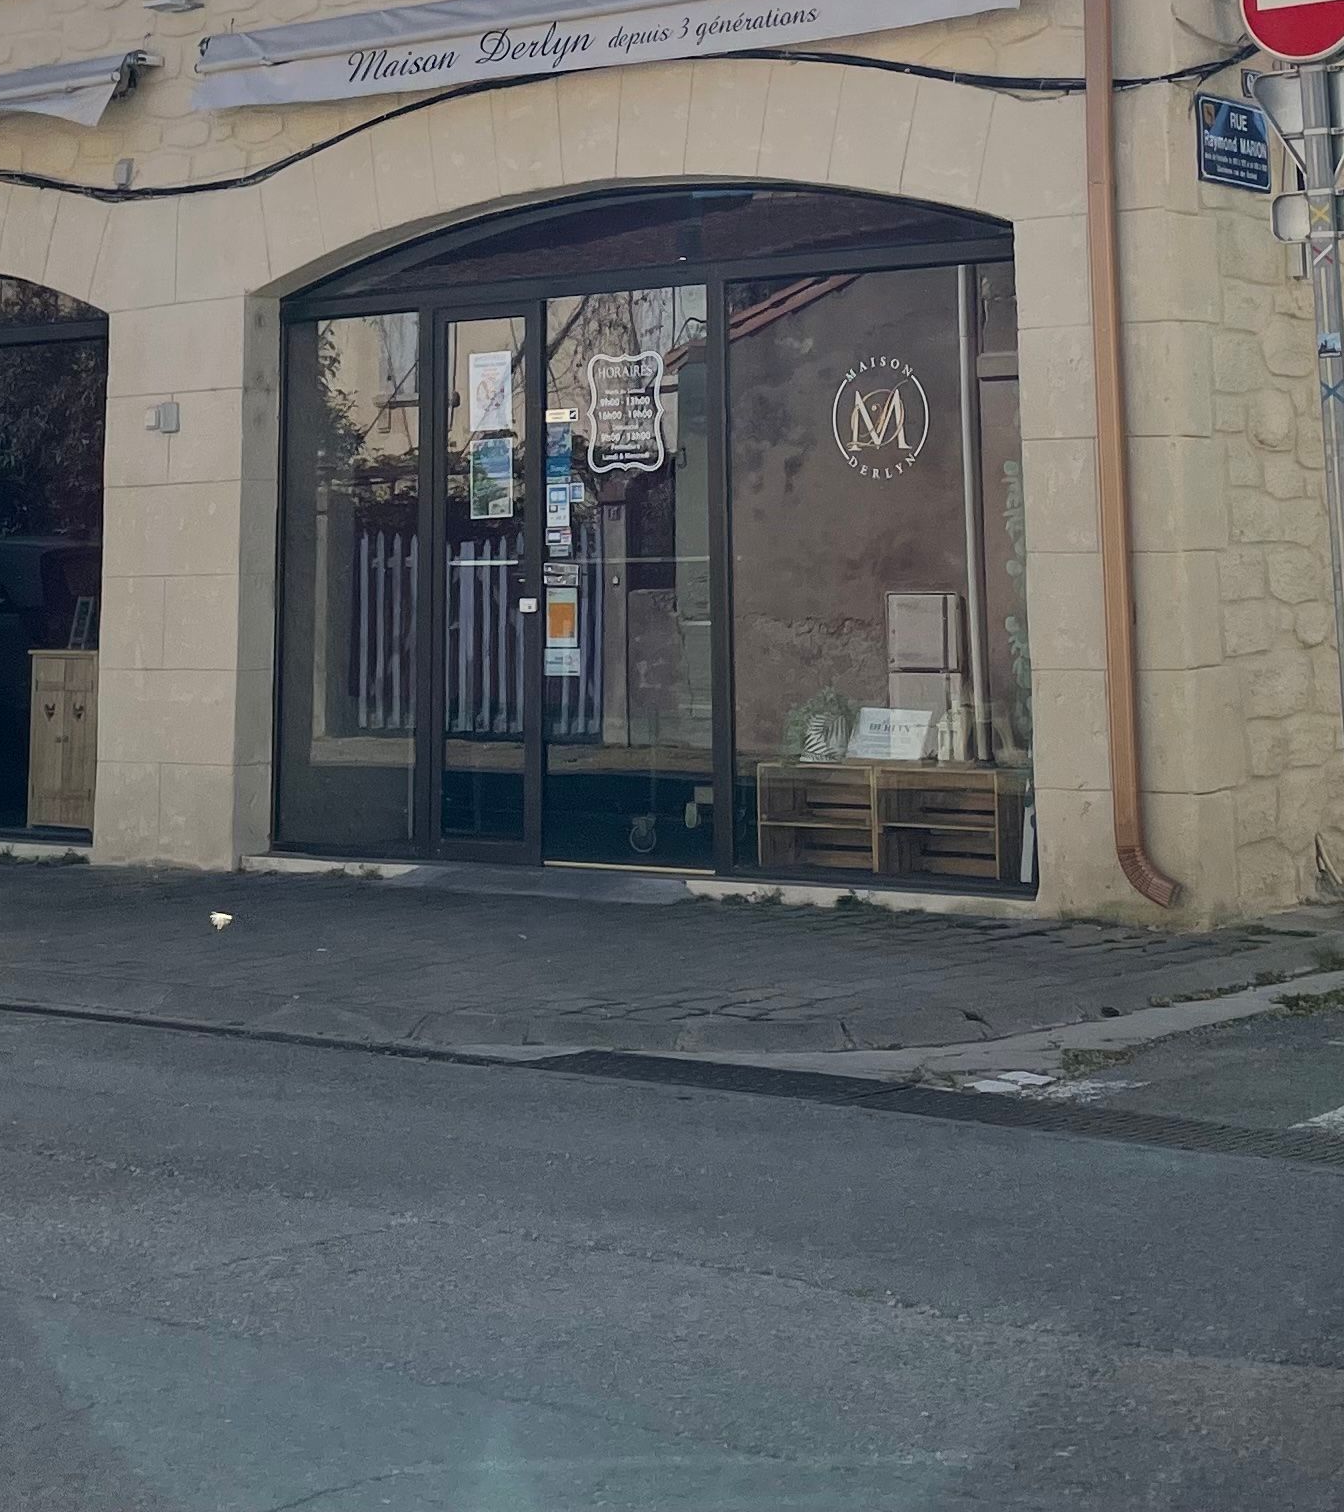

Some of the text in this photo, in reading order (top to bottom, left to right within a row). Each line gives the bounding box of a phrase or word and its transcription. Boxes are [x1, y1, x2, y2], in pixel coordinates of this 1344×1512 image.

[348, 7, 820, 83] Maison Derlyn depuis 3 générations
[1229, 112, 1248, 132] RUE
[598, 365, 653, 379] HORAIRES
[845, 355, 913, 382] MAISON
[848, 452, 916, 480] DERLYN
